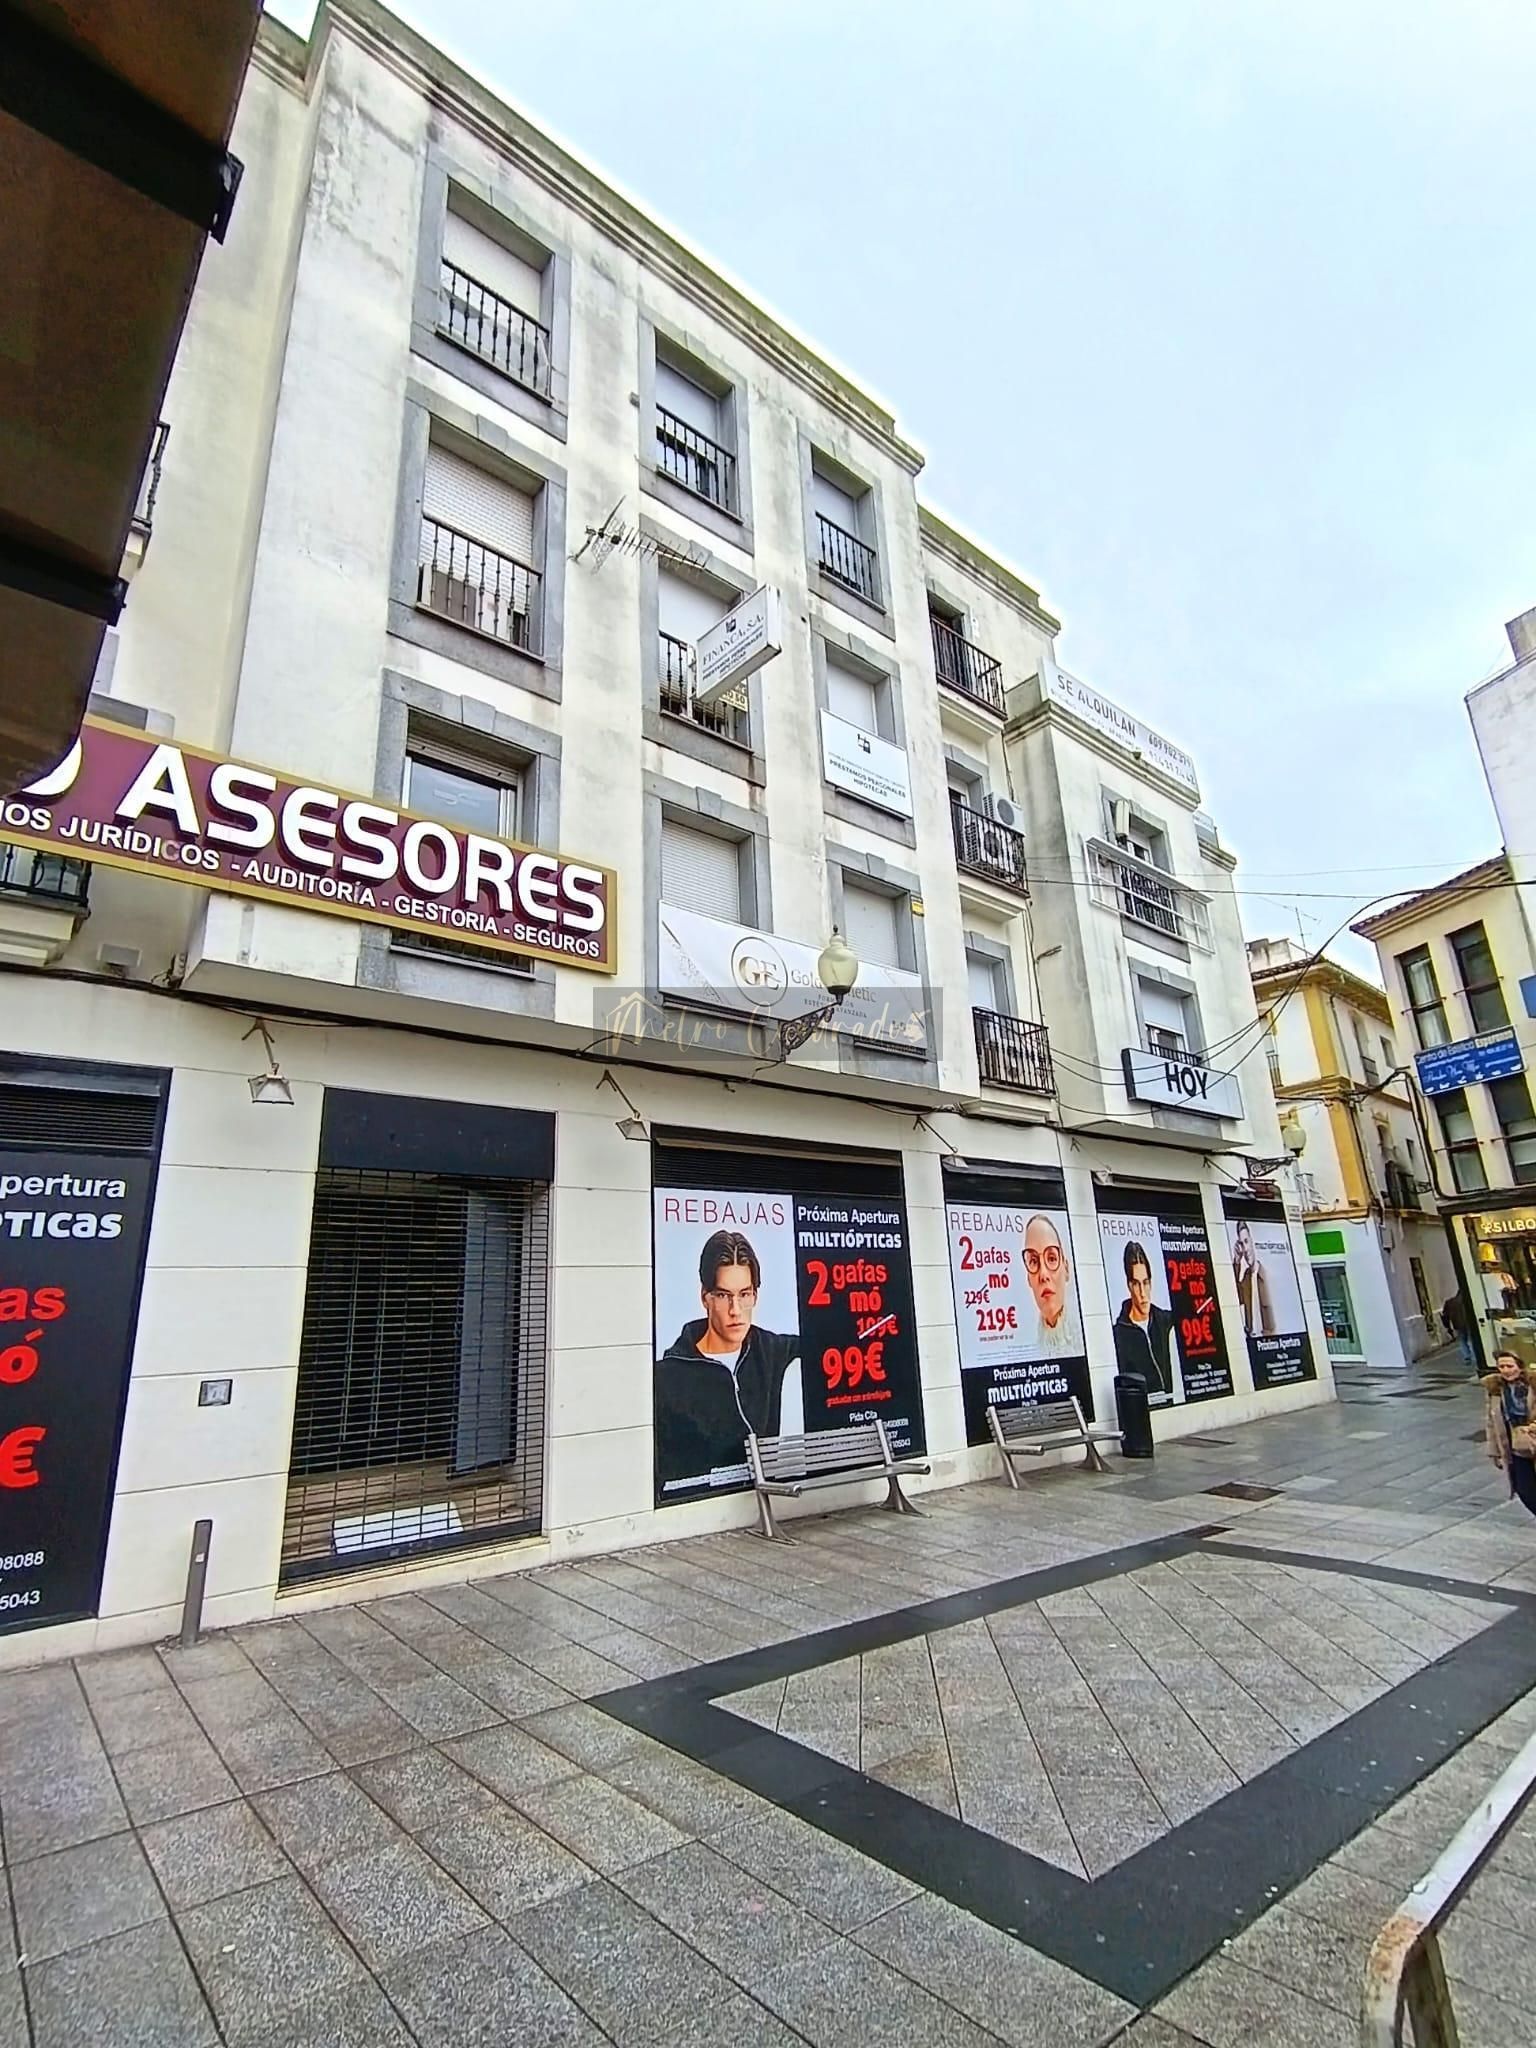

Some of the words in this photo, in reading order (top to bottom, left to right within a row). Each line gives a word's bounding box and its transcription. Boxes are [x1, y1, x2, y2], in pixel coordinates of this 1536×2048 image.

[1057, 674, 1074, 697] SE
[1078, 689, 1137, 738] ALQUILAN
[115, 743, 606, 934] ASESORES
[59, 816, 220, 870] JURÍDICOS
[243, 857, 376, 908] AUDITORÍA
[394, 895, 498, 935] GESTORIA
[513, 922, 600, 958] SEGUROS
[738, 956, 781, 991] GE
[1165, 1062, 1208, 1100] HOY
[0, 1173, 126, 1199] pertura
[0, 1211, 123, 1239] TICas
[665, 1198, 785, 1225] REBAJAS
[798, 1205, 849, 1222] Próxima
[851, 1208, 900, 1226] Apertura
[950, 1211, 1024, 1233] REBAJAS
[1102, 1219, 1154, 1237] REBAJAS
[1491, 1219, 1536, 1233] SILBO
[959, 1235, 975, 1270] 2
[975, 1246, 1011, 1268] gafas
[807, 1260, 831, 1305] 2
[832, 1259, 887, 1289] gafas
[988, 1267, 1009, 1288] mó
[1168, 1260, 1181, 1291] 2
[1180, 1259, 1206, 1280] gafas
[850, 1286, 881, 1312] mó
[976, 1306, 1018, 1331] 219€
[1182, 1315, 1213, 1346] 99€
[822, 1342, 887, 1389] 99€
[993, 1366, 1027, 1381] Próxima
[1028, 1362, 1060, 1379] Apertura
